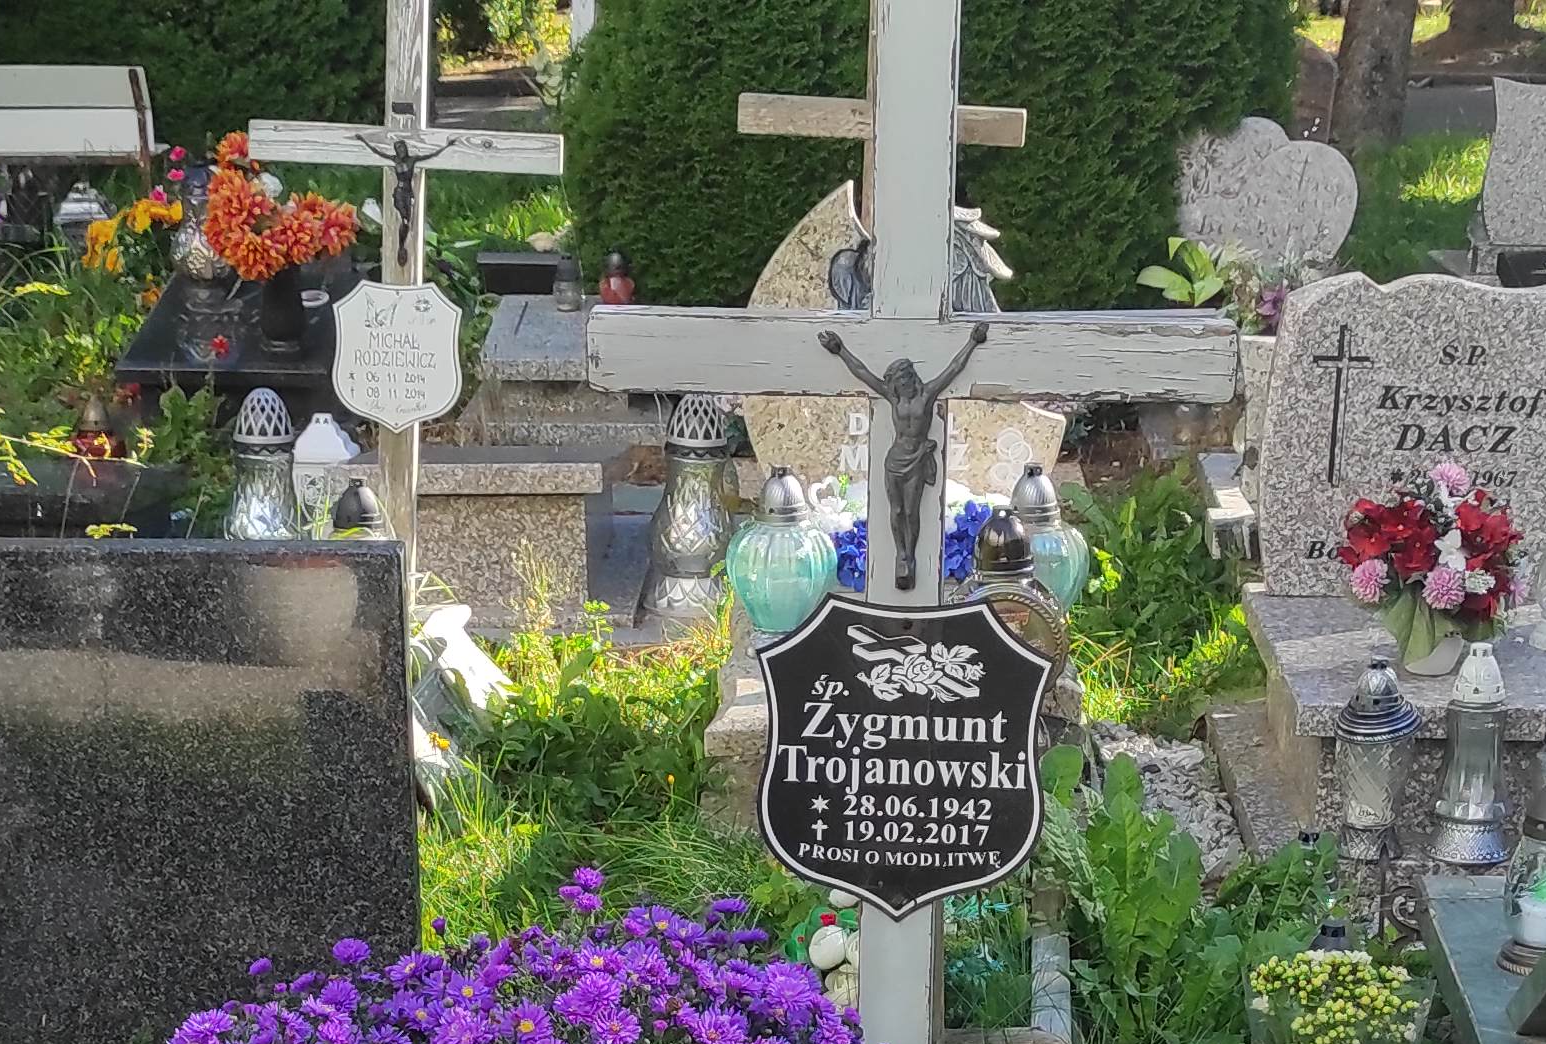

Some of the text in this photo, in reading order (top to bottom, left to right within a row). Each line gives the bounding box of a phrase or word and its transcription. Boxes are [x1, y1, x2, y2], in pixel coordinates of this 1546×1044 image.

[354, 349, 436, 369] RODZIEWICZ
[1394, 423, 1519, 453] DACZ
[811, 675, 850, 700] śp.
[801, 701, 1008, 749] Zygmunt
[778, 744, 1027, 795] Trojanowski
[843, 795, 992, 821] 28.06.1942
[844, 820, 990, 846] 19.02.2017
[797, 842, 1003, 869] PROSI O MODLITWĘ
